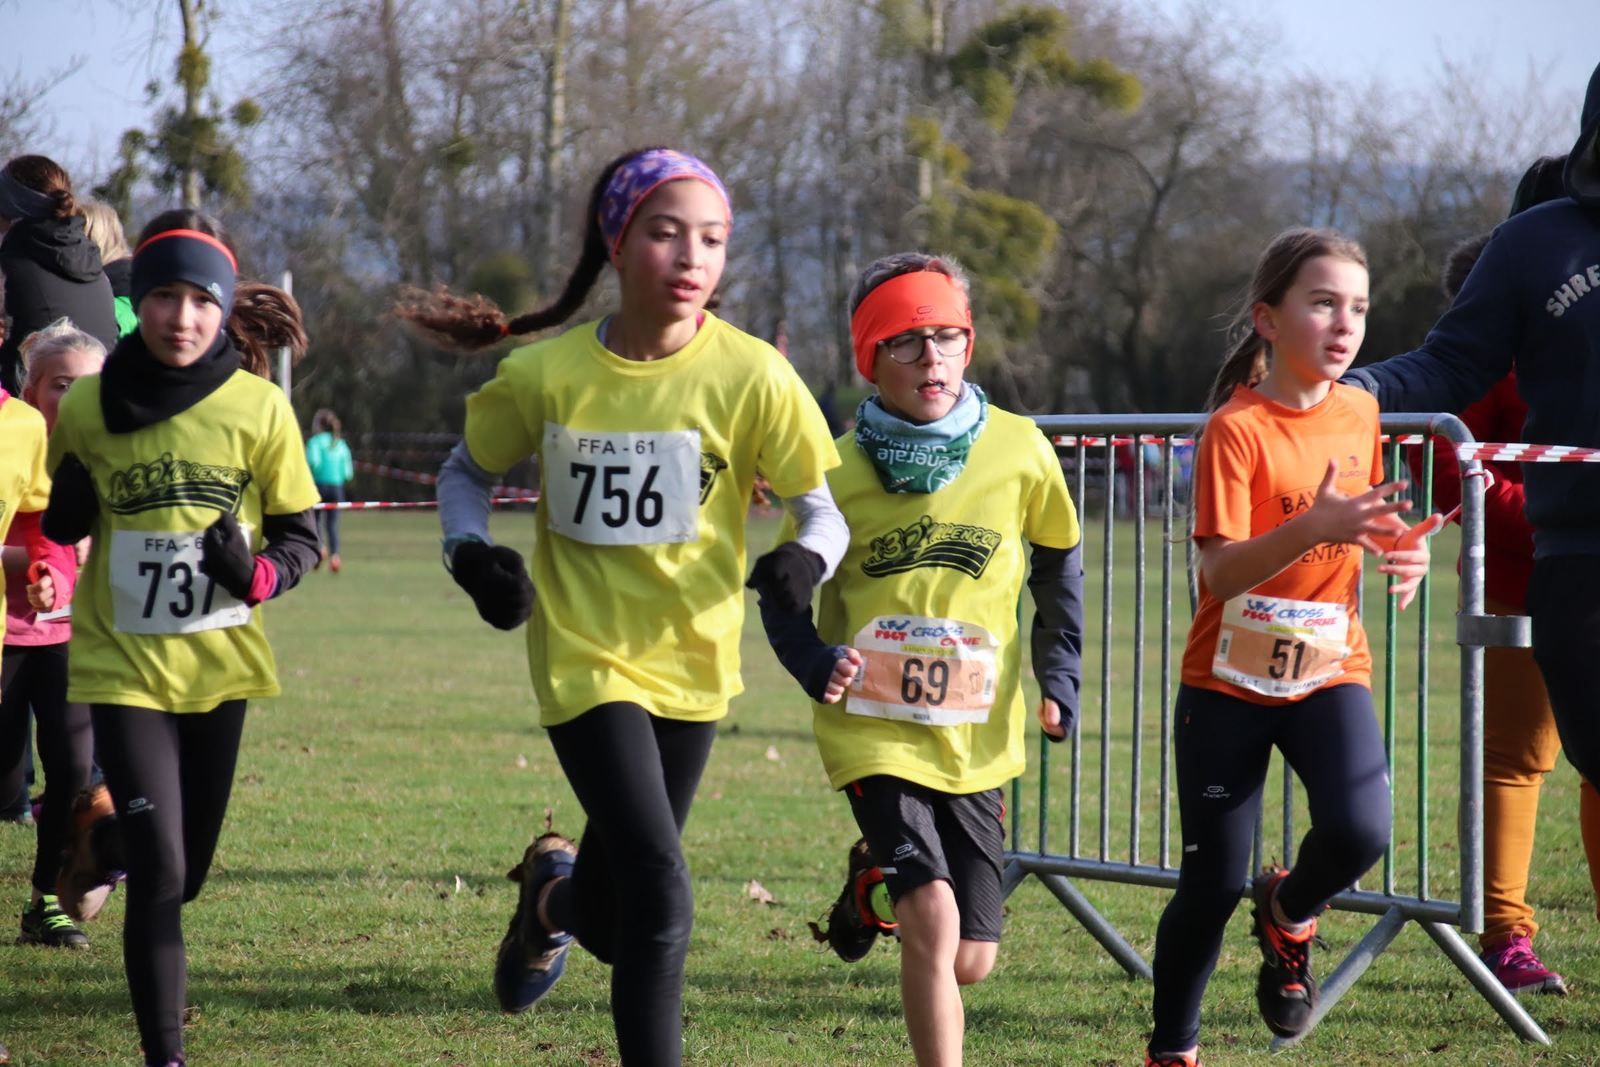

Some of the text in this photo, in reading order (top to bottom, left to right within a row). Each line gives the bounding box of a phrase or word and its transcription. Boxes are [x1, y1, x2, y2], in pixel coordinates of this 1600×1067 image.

[578, 438, 616, 455] FFA
[636, 440, 655, 454] 61
[570, 462, 663, 528] 756
[145, 538, 178, 552] FFA
[1277, 608, 1324, 618] CROSS
[1268, 639, 1306, 680] 51
[901, 658, 949, 706] 69
